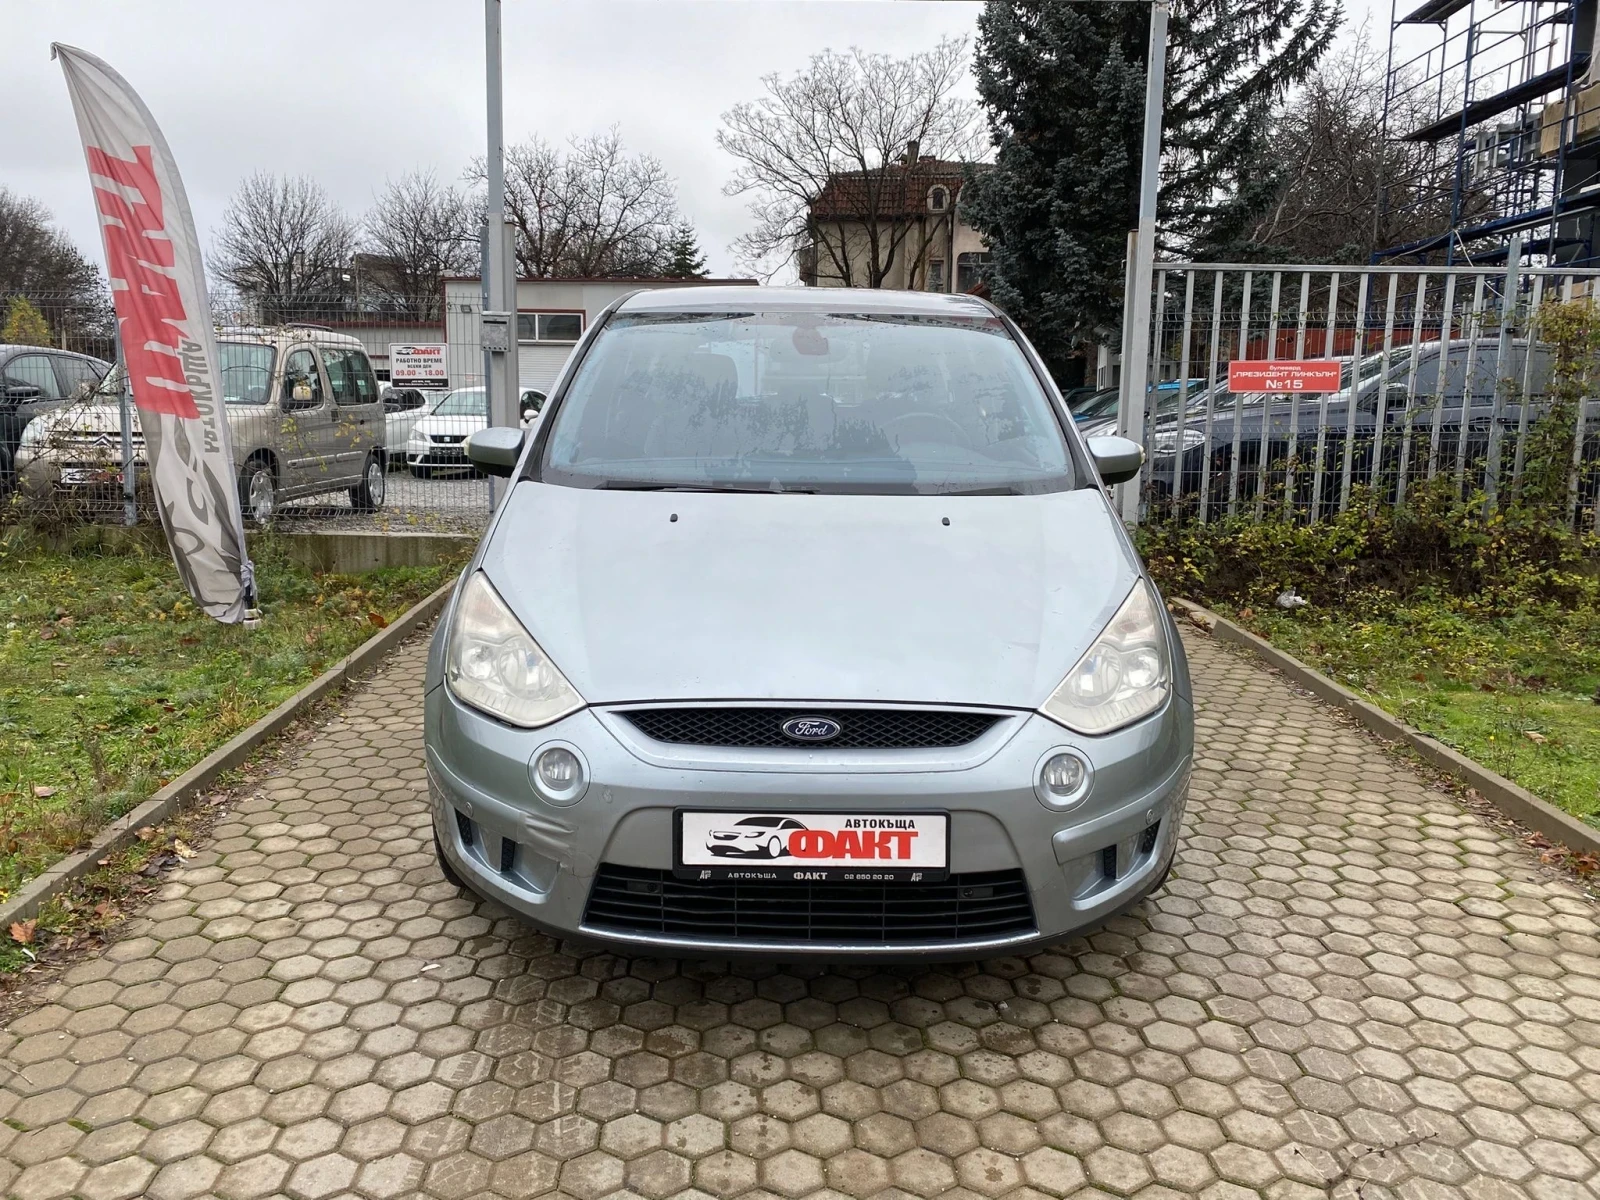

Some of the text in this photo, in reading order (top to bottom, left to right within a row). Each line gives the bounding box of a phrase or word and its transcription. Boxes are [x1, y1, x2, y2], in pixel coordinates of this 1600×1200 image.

[795, 721, 828, 735] Ford
[844, 818, 916, 831] АВТОКЪЩА
[787, 829, 919, 860] ФАКТ
[793, 871, 828, 880] ФАКТ
